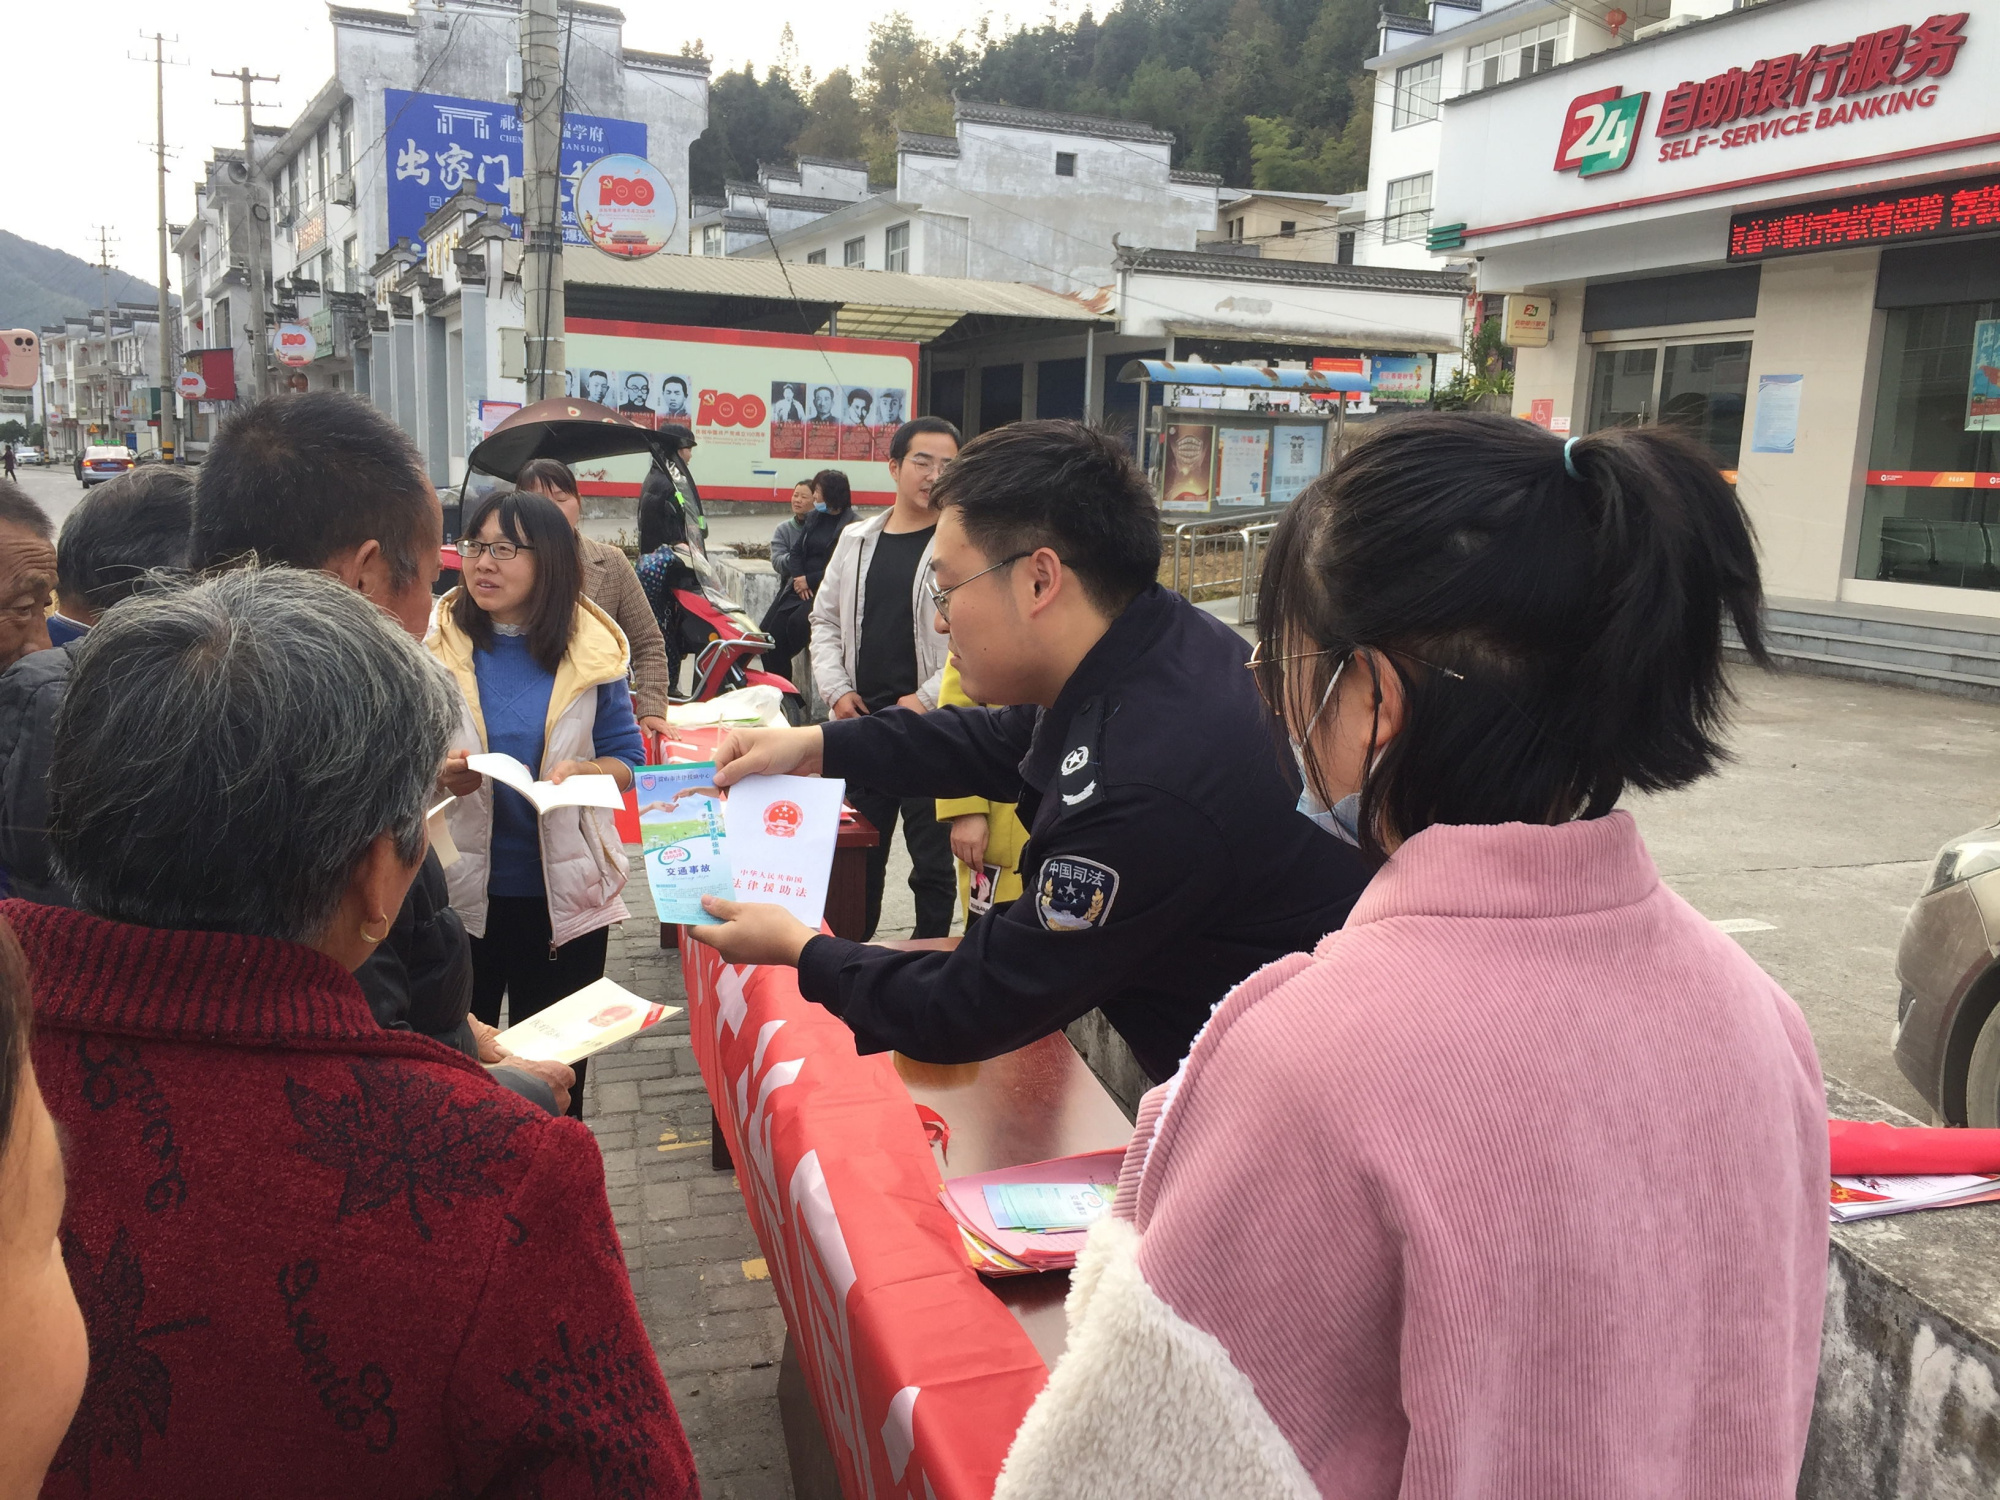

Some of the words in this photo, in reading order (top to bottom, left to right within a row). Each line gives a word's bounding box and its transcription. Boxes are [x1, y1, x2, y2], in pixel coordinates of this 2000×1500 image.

[1656, 13, 1970, 138] 自助银行服务
[1564, 103, 1627, 161] 24
[1658, 113, 1814, 162] SELF-SERVICE
[1814, 84, 1940, 129] BANKING
[666, 864, 711, 876] 交通事故
[741, 869, 803, 883] 中华人民共和国
[1049, 861, 1105, 887] 中国司法
[733, 878, 807, 897] 法律援助法
